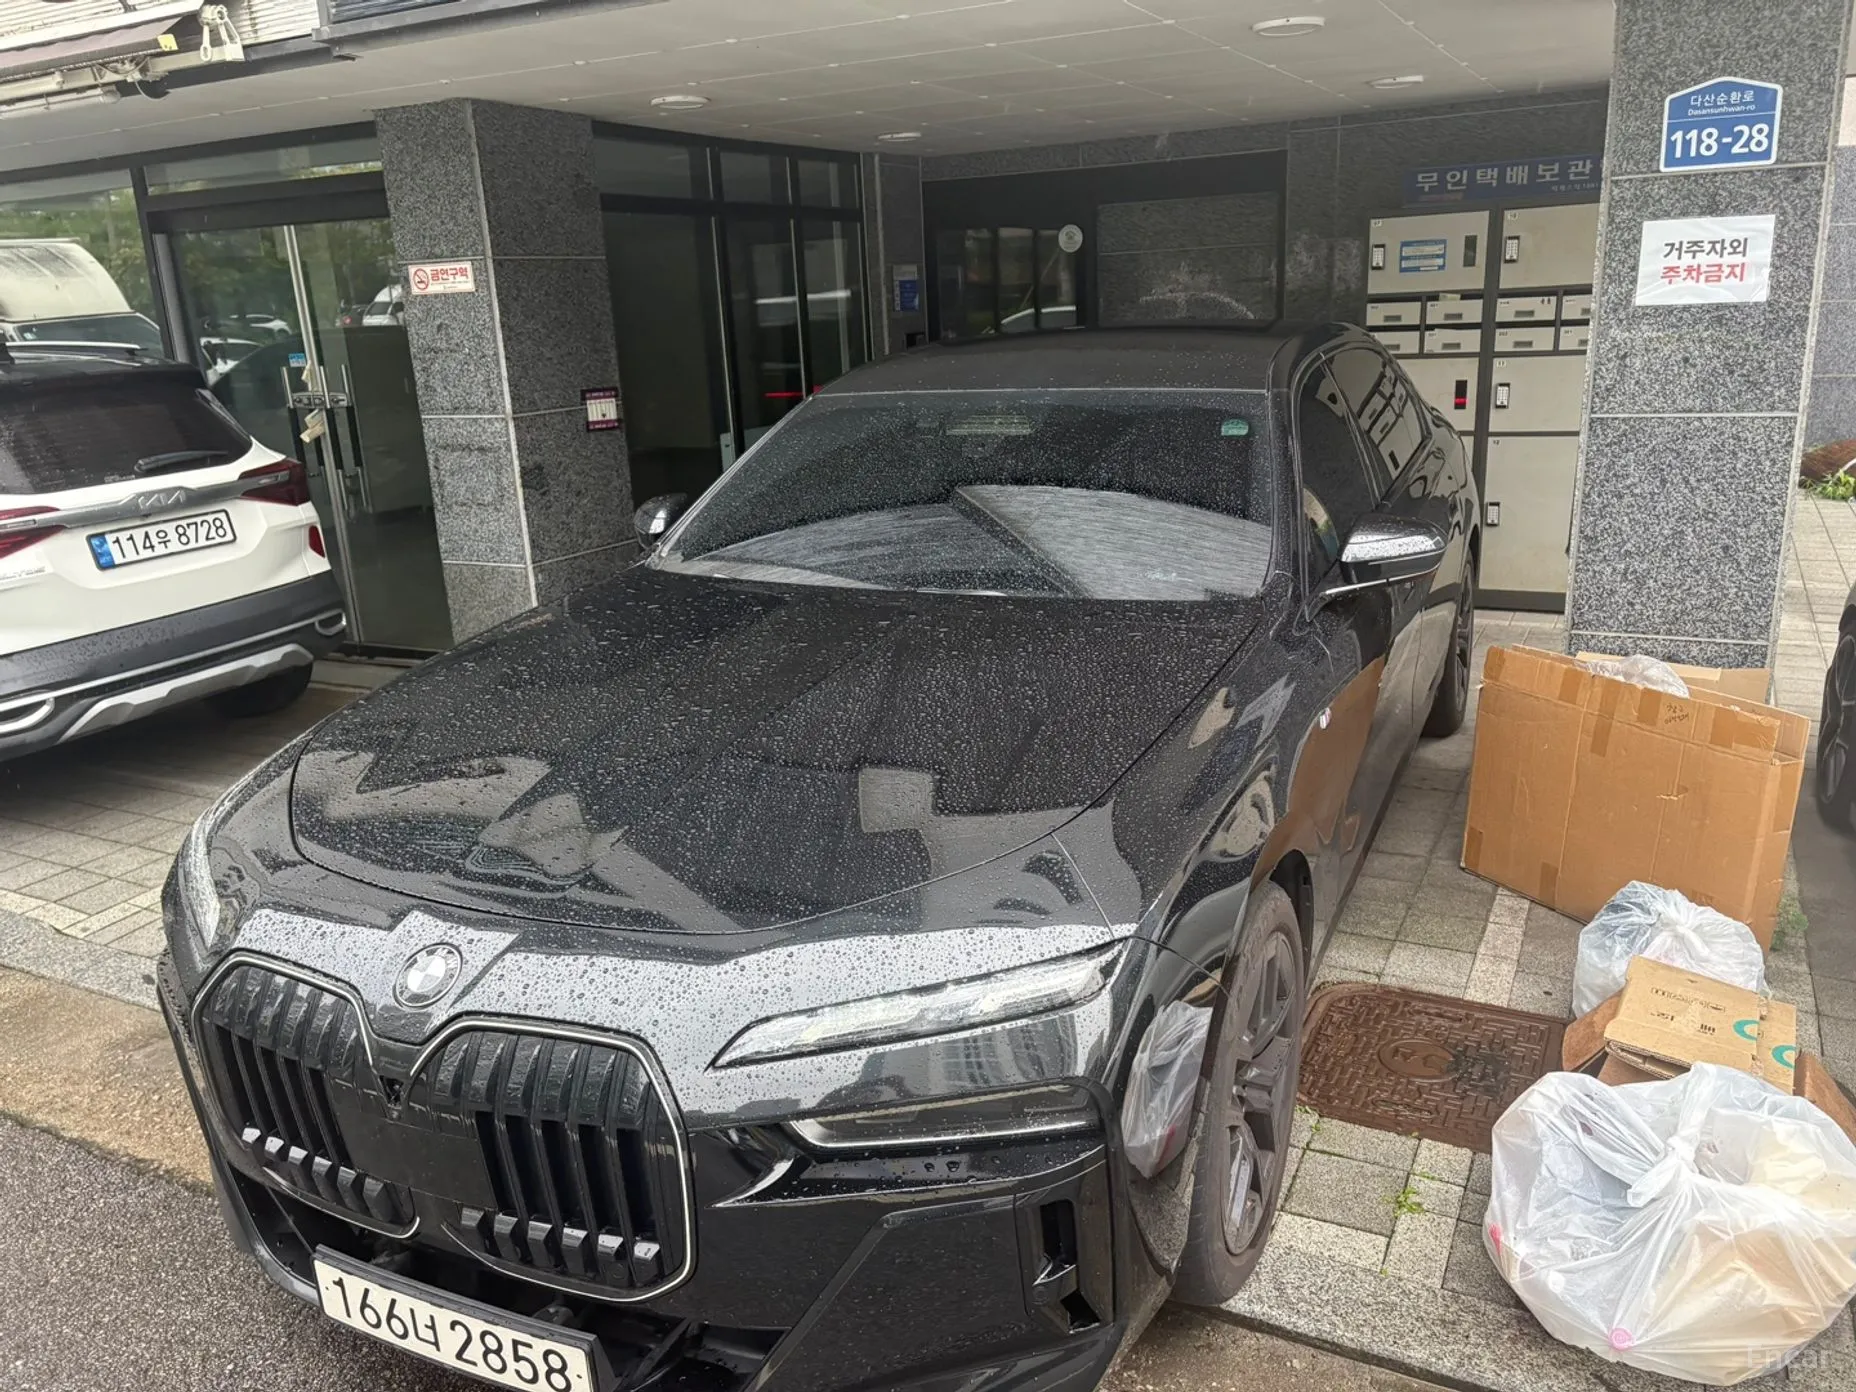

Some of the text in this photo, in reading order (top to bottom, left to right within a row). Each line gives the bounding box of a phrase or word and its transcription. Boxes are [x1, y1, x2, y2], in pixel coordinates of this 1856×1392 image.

[1687, 104, 1756, 116] Dasansunhwan-ro
[1690, 90, 1755, 107] 다산순환로
[1670, 123, 1770, 159] 118-28
[1416, 160, 1603, 193] 무인택배보관
[1663, 237, 1749, 260] 거주자외
[430, 267, 469, 281] 금연구역
[1660, 262, 1746, 285] 주차금지
